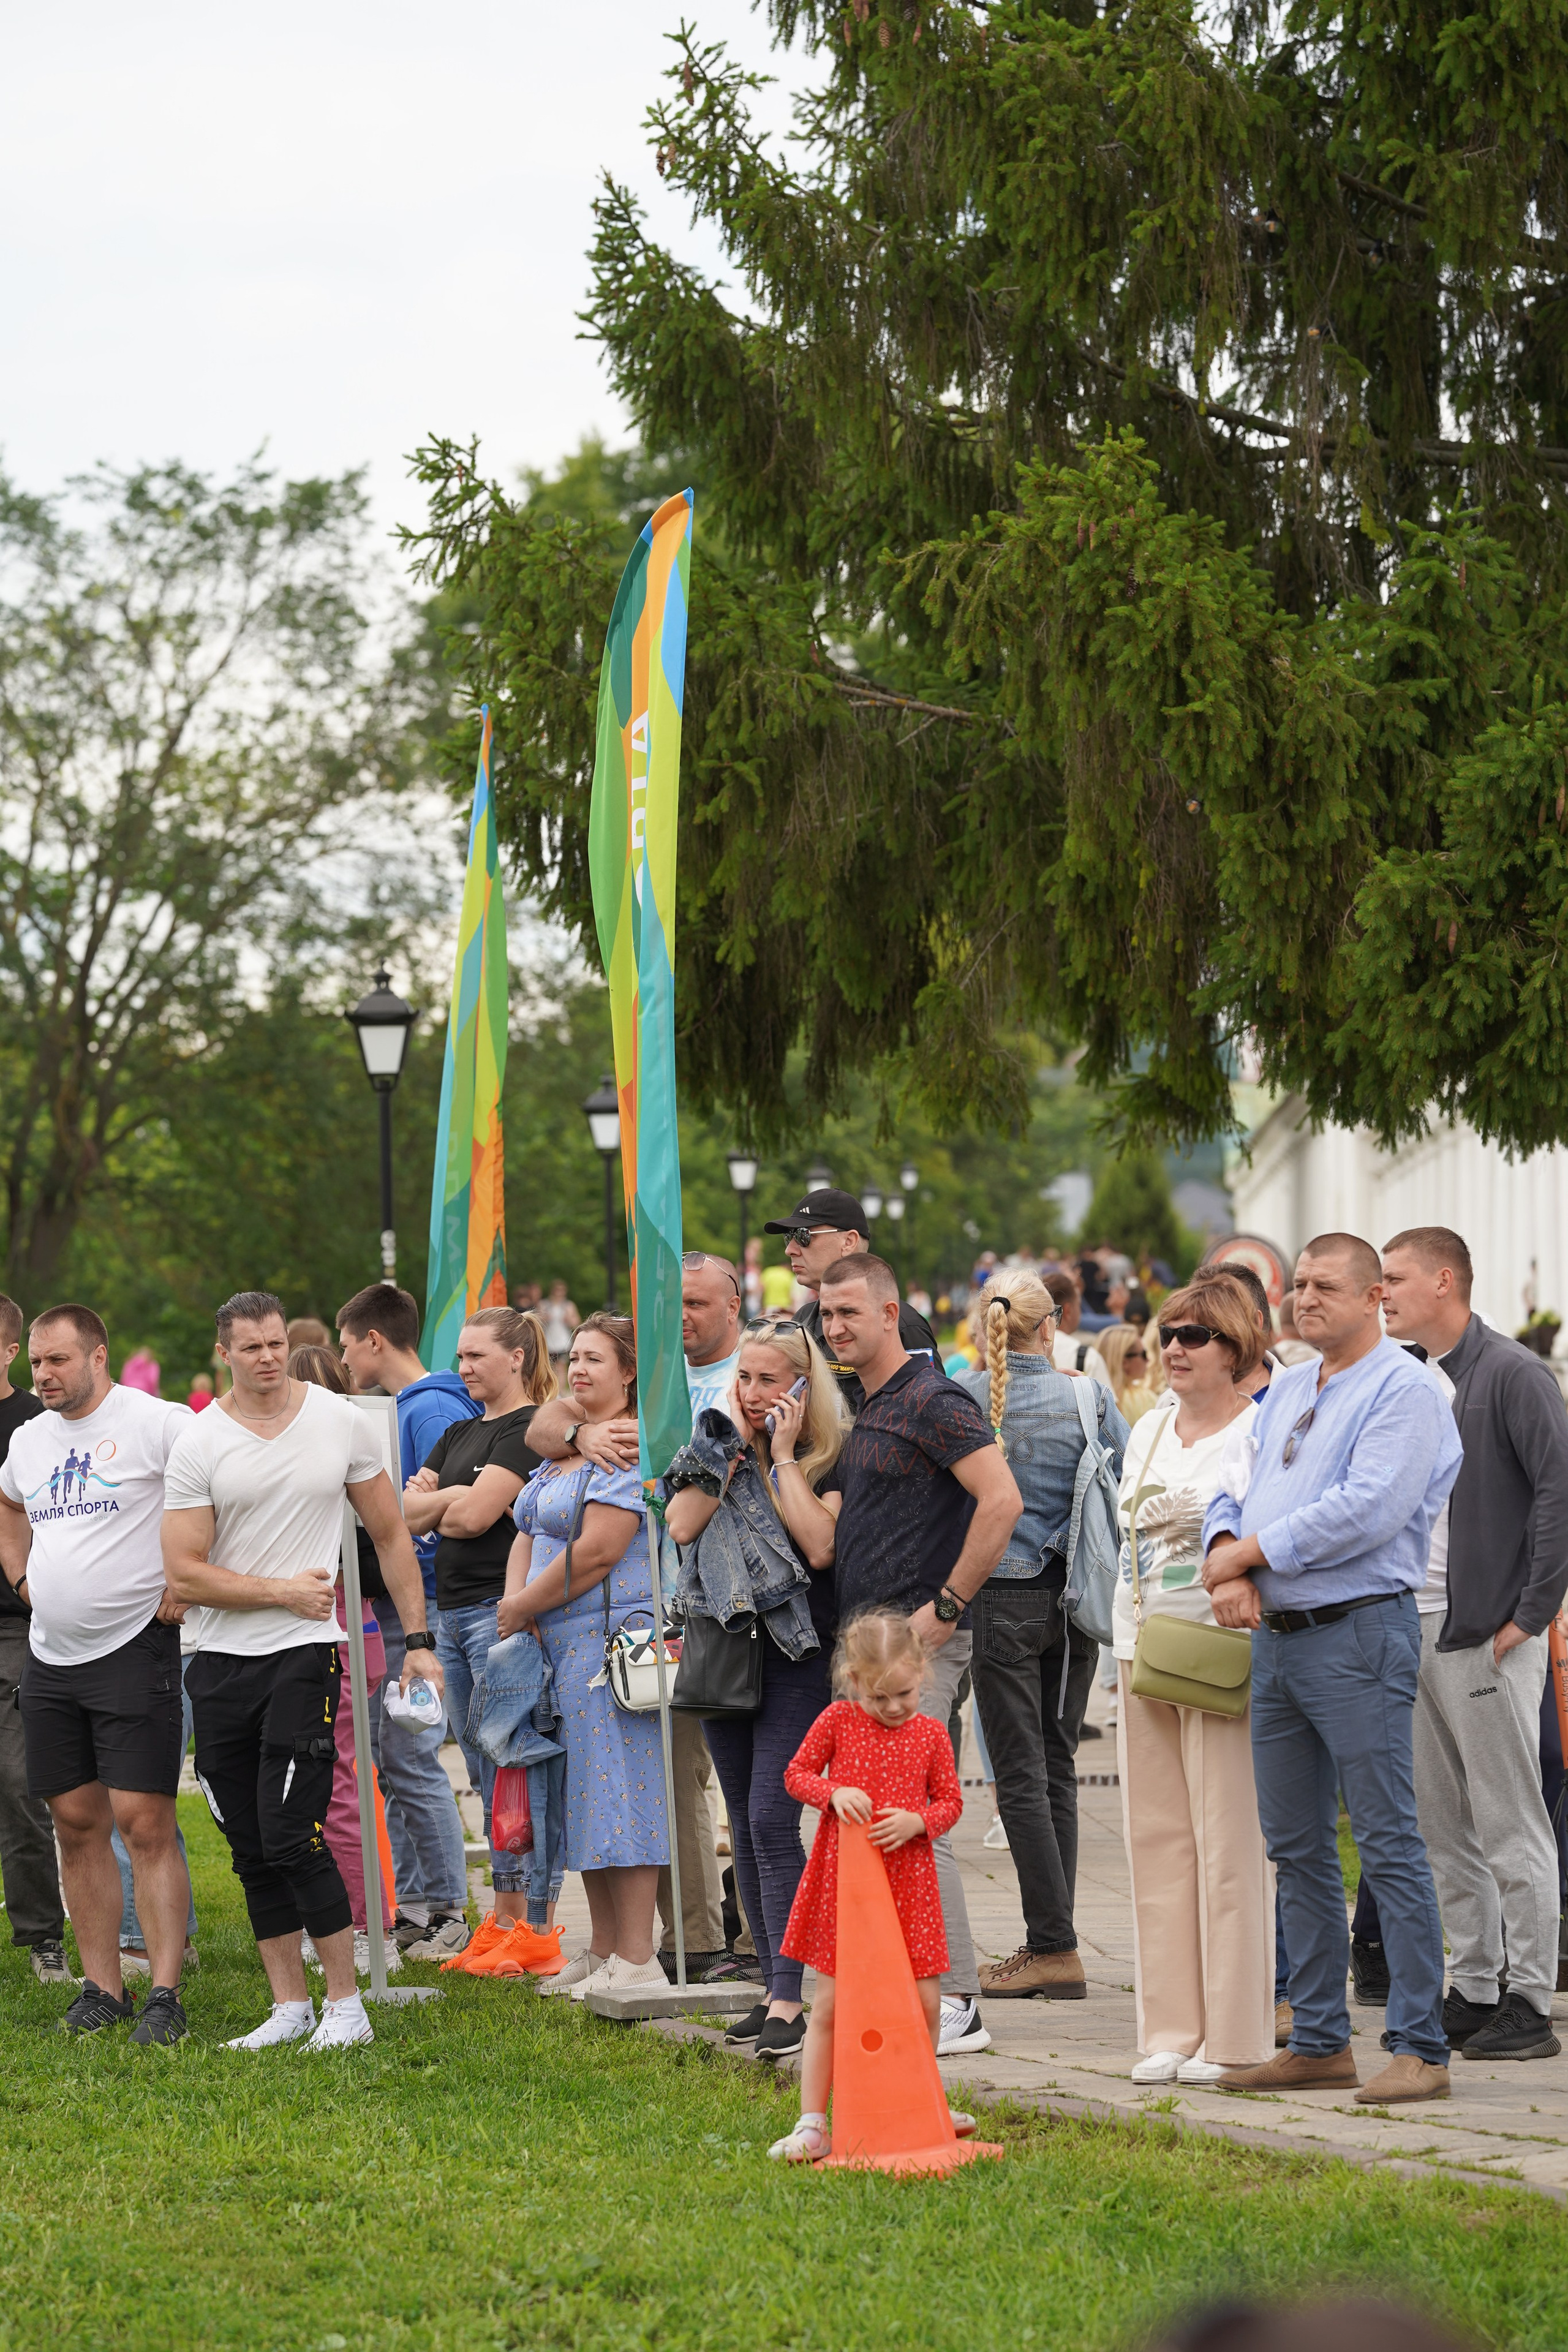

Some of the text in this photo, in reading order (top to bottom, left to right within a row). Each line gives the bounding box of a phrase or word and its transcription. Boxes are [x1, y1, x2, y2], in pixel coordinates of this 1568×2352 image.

[30, 1500, 119, 1523] ЗЕМЛЯ СПОРТА
[1469, 1686, 1498, 1698] adidas
